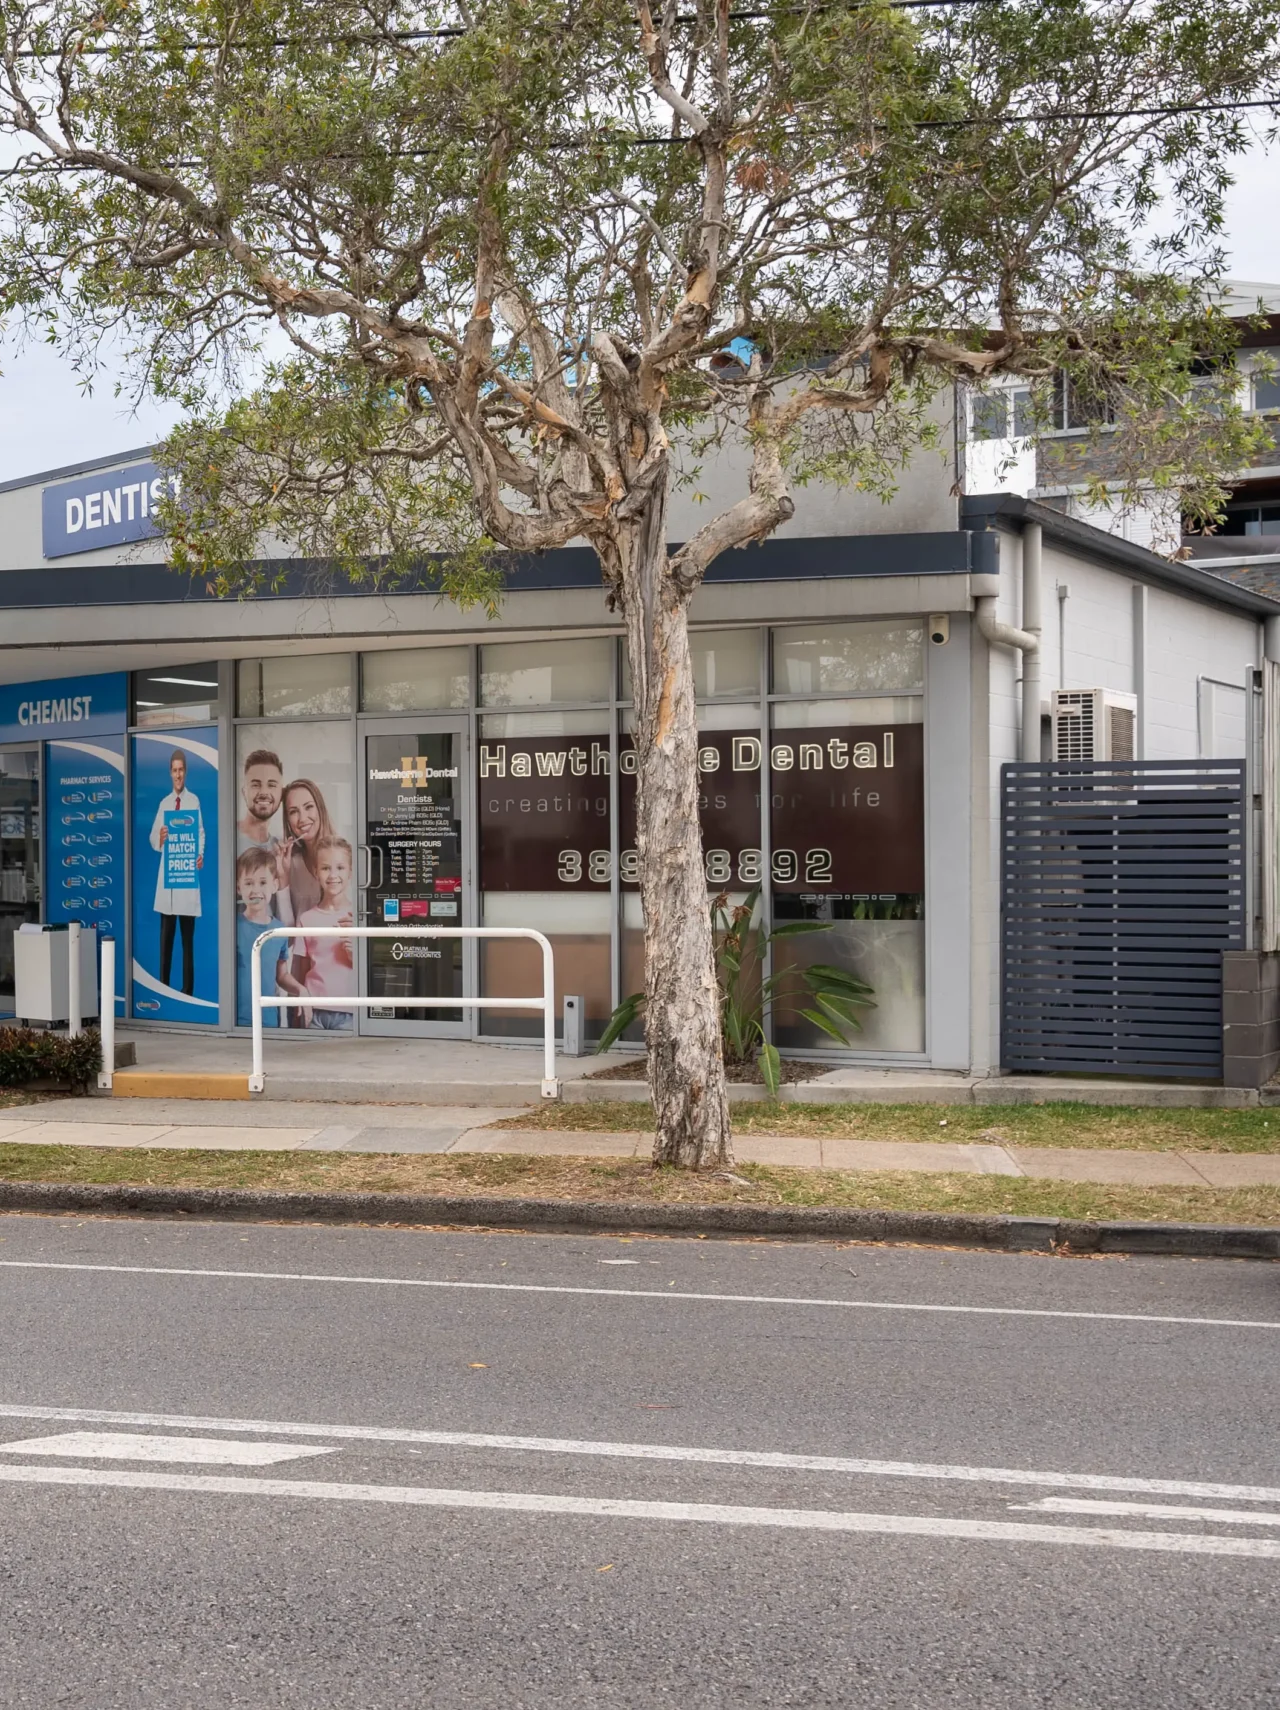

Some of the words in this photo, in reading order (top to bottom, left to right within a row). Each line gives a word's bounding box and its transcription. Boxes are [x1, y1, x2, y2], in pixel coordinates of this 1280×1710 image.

[18, 696, 92, 726] CHEMIST
[480, 743, 720, 777] Hawthoe
[732, 733, 894, 771] Dental
[369, 768, 424, 780] Hawthorne
[426, 767, 458, 778] Dental
[60, 777, 88, 785] PHARMACY
[89, 775, 111, 783] SERVICES
[397, 795, 433, 803] Dentists
[489, 793, 608, 817] creating
[169, 834, 178, 842] WE
[180, 833, 195, 841] WILL
[169, 843, 195, 853] MATCH
[169, 859, 195, 871] PRICE
[558, 850, 640, 882] 389
[706, 848, 833, 884] 8892
